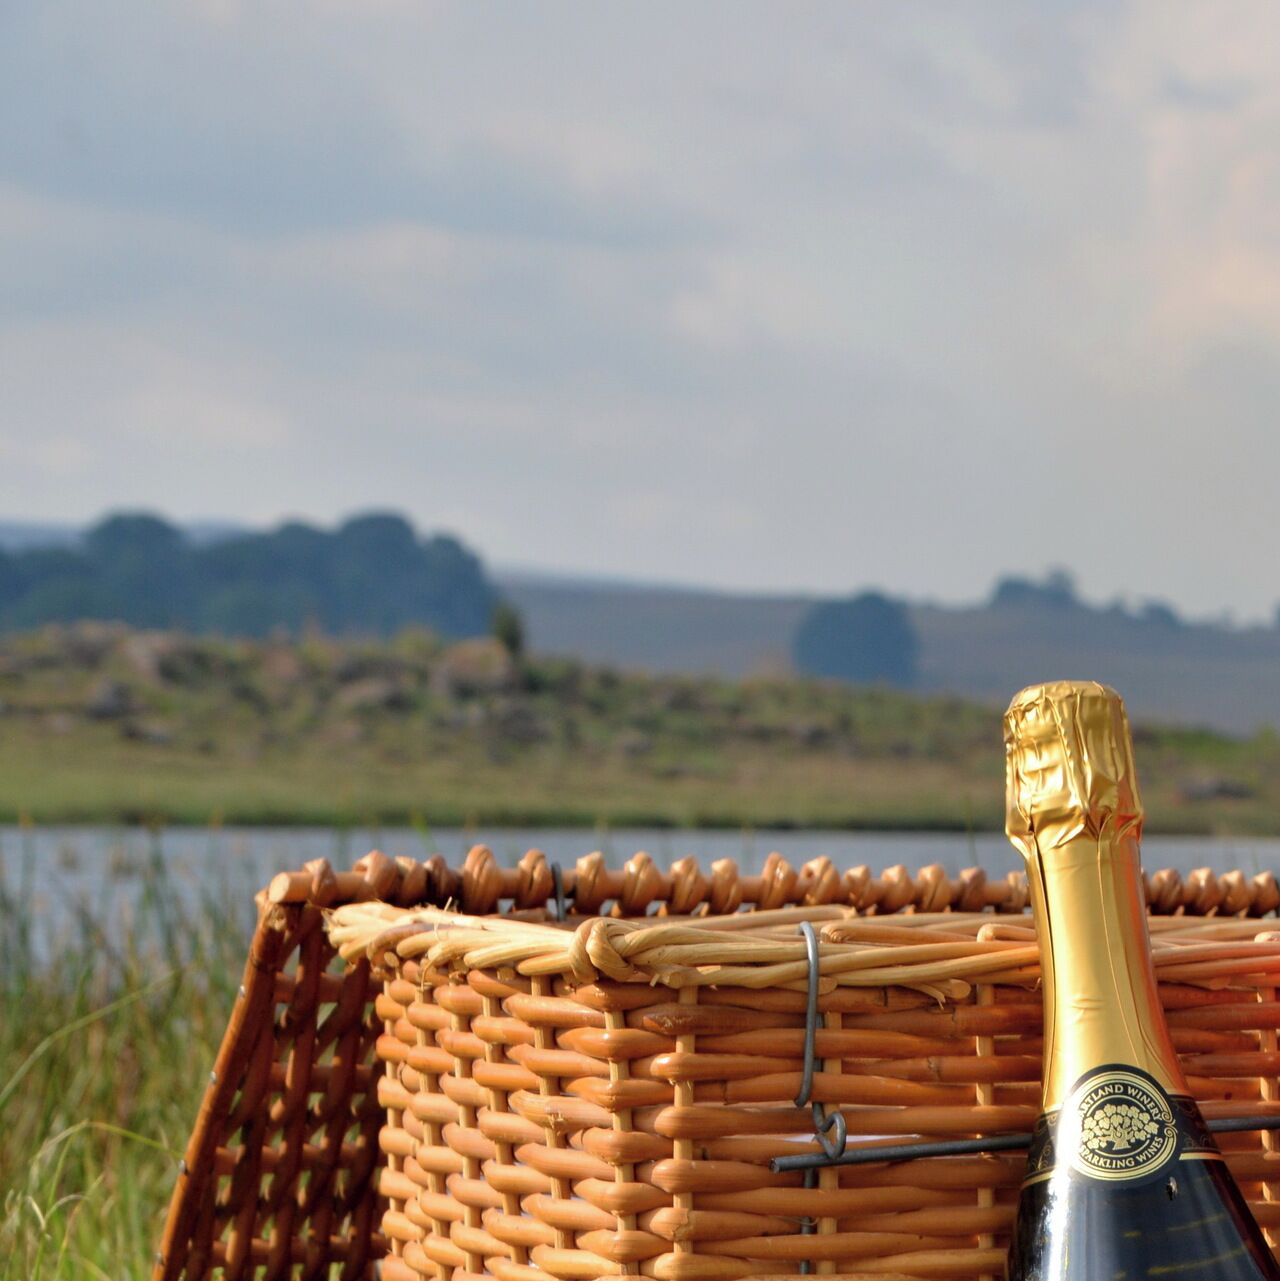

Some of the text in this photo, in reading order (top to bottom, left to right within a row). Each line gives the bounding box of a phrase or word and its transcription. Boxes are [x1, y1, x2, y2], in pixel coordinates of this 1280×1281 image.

[1128, 1087, 1162, 1121] WINERY
[1079, 1137, 1163, 1168] SPARKLING WINES
